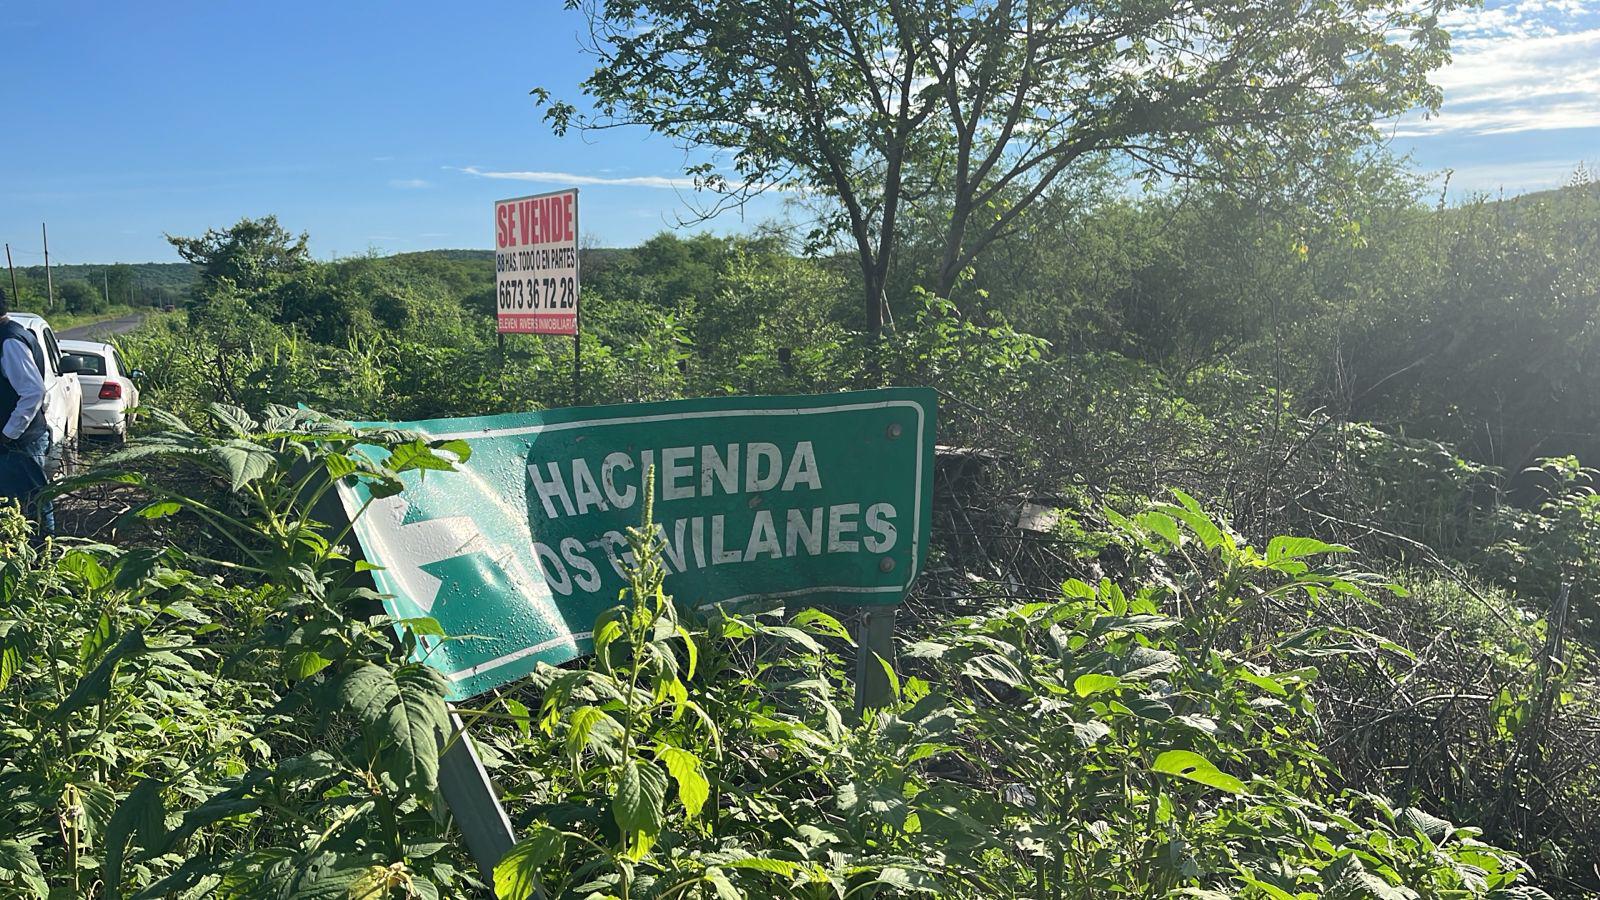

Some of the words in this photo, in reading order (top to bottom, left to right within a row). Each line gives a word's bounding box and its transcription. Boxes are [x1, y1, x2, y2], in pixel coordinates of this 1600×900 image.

[498, 203, 516, 248] SE
[519, 195, 574, 245] VENDE
[519, 251, 534, 271] TODO
[536, 250, 541, 270] O
[542, 249, 550, 270] EN
[551, 247, 575, 269] PARTES
[499, 279, 524, 309] 6673
[527, 278, 540, 309] 36
[543, 278, 556, 308] 72
[560, 277, 574, 308] 28
[498, 318, 518, 329] ELEVEN
[519, 318, 539, 330] RIVERS
[528, 441, 822, 518] HACIENDA
